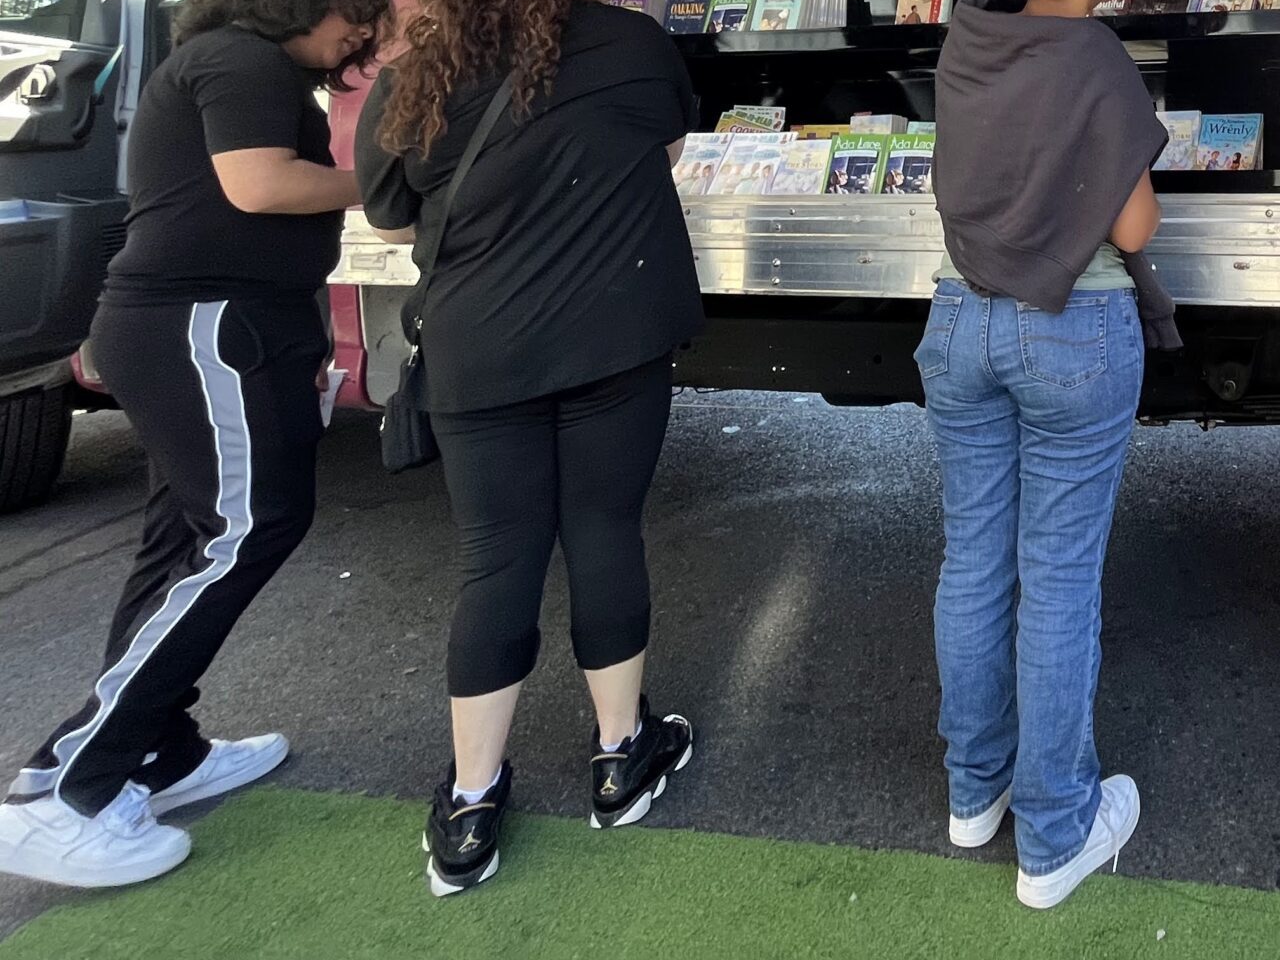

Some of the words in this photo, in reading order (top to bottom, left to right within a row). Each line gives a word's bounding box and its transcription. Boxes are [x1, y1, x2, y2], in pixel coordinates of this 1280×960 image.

[1209, 122, 1254, 139] Wrenly
[834, 136, 855, 151] Ada
[889, 136, 912, 151] Ada
